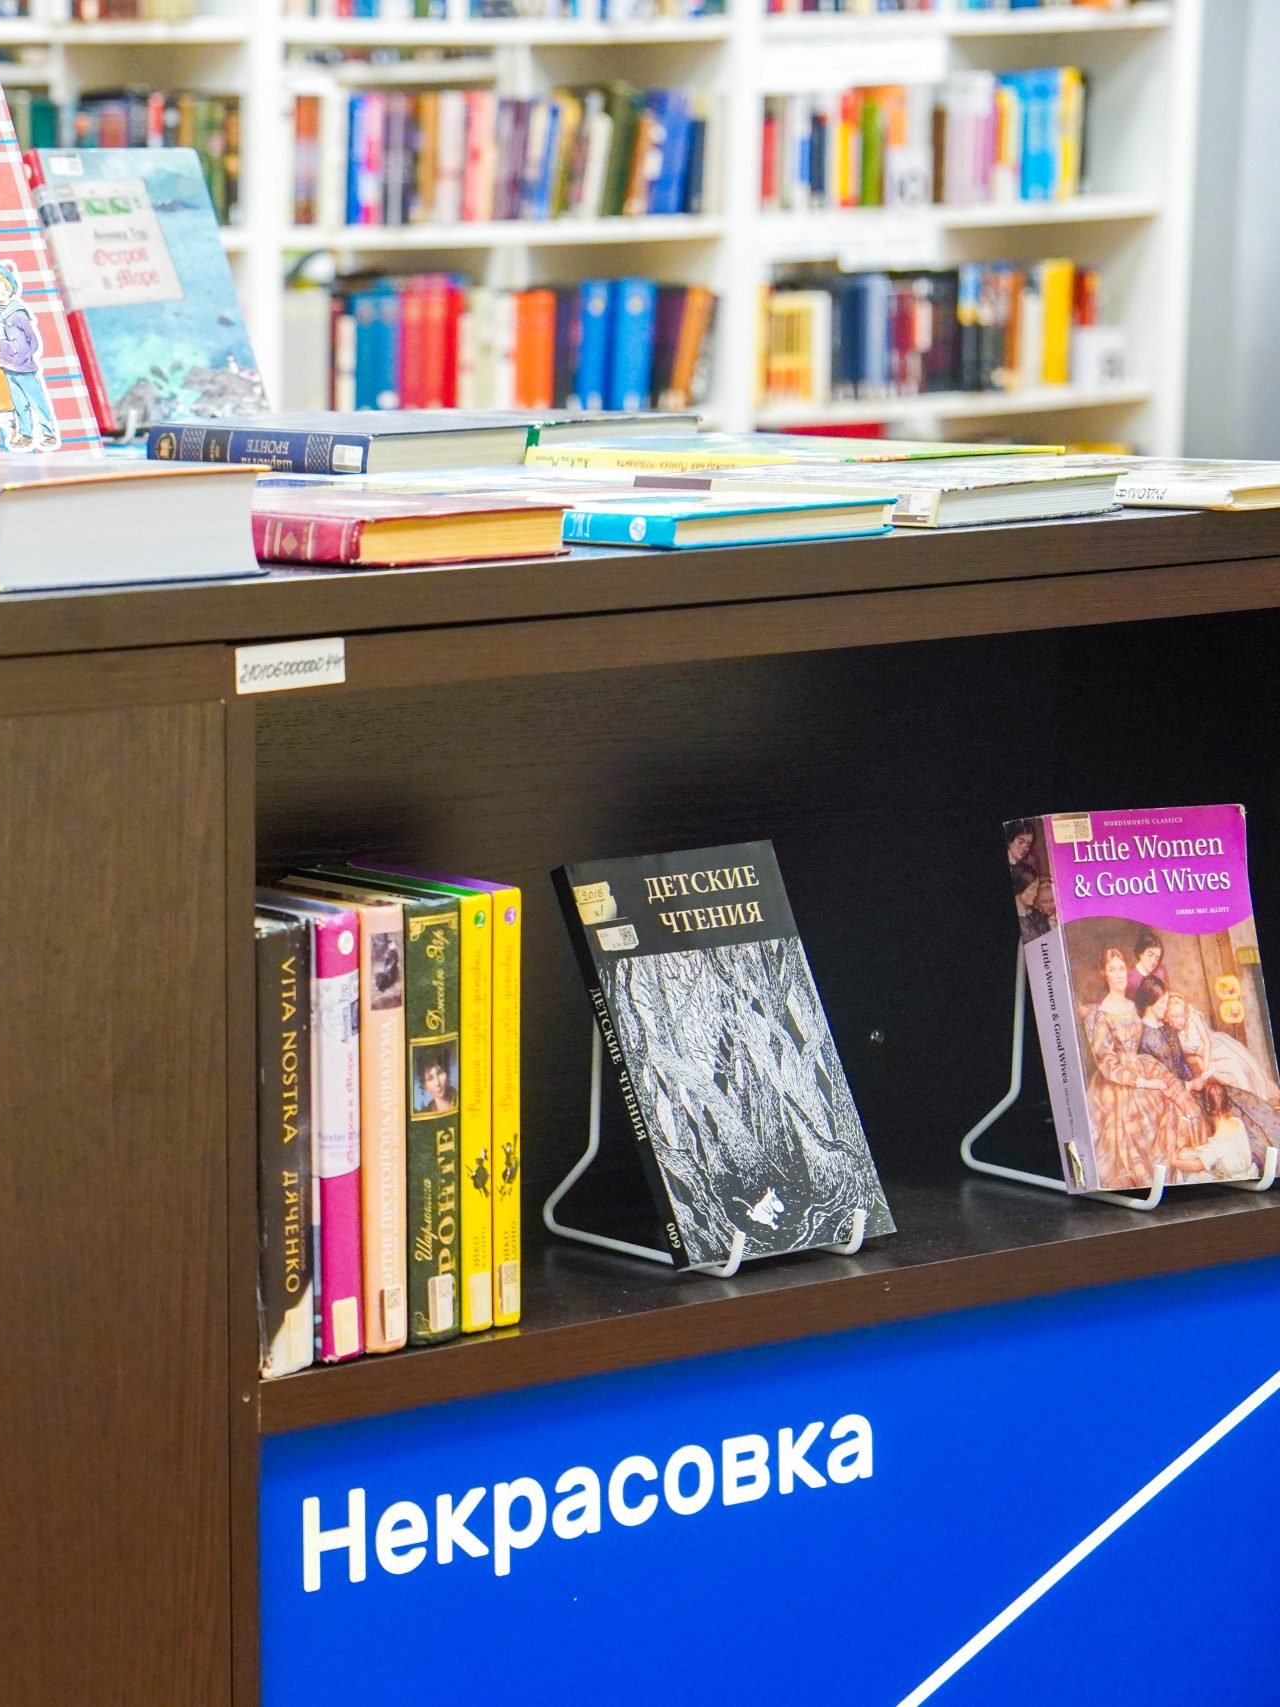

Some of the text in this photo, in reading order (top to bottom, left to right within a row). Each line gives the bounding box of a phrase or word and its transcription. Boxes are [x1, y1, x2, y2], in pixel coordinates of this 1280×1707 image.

[246, 439, 289, 454] БРОНТЕ
[1115, 488, 1168, 500] РУДОЛЬФ
[1104, 816, 1183, 827] WORDSWORTH CLASSICS
[1073, 834, 1225, 863] Little Women
[581, 888, 604, 902] 2016
[644, 865, 760, 904] ДЕТСКИЕ
[1074, 867, 1231, 898] & Good Wives
[475, 911, 485, 928] 2
[659, 901, 765, 934] ЧТЕНИЯ
[1175, 907, 1195, 915] LOUISA
[1209, 906, 1230, 914] ALCOTT
[1040, 942, 1050, 970] Little
[1042, 969, 1057, 1011] Women
[1053, 1023, 1065, 1051] Good
[589, 988, 646, 1142] ДЕТСКИЕ ЧТЕНИЯ
[1057, 1050, 1068, 1084] Wives
[281, 956, 300, 1294] VITA NOSTRA ДЯЧЕНКО
[380, 1117, 393, 1229] ПРОТОПОПА
[414, 1177, 439, 1261] Шарлотта
[437, 1127, 456, 1278] РОНТЕ
[665, 1222, 681, 1250] 009
[302, 1413, 874, 1593] Некрасовка
